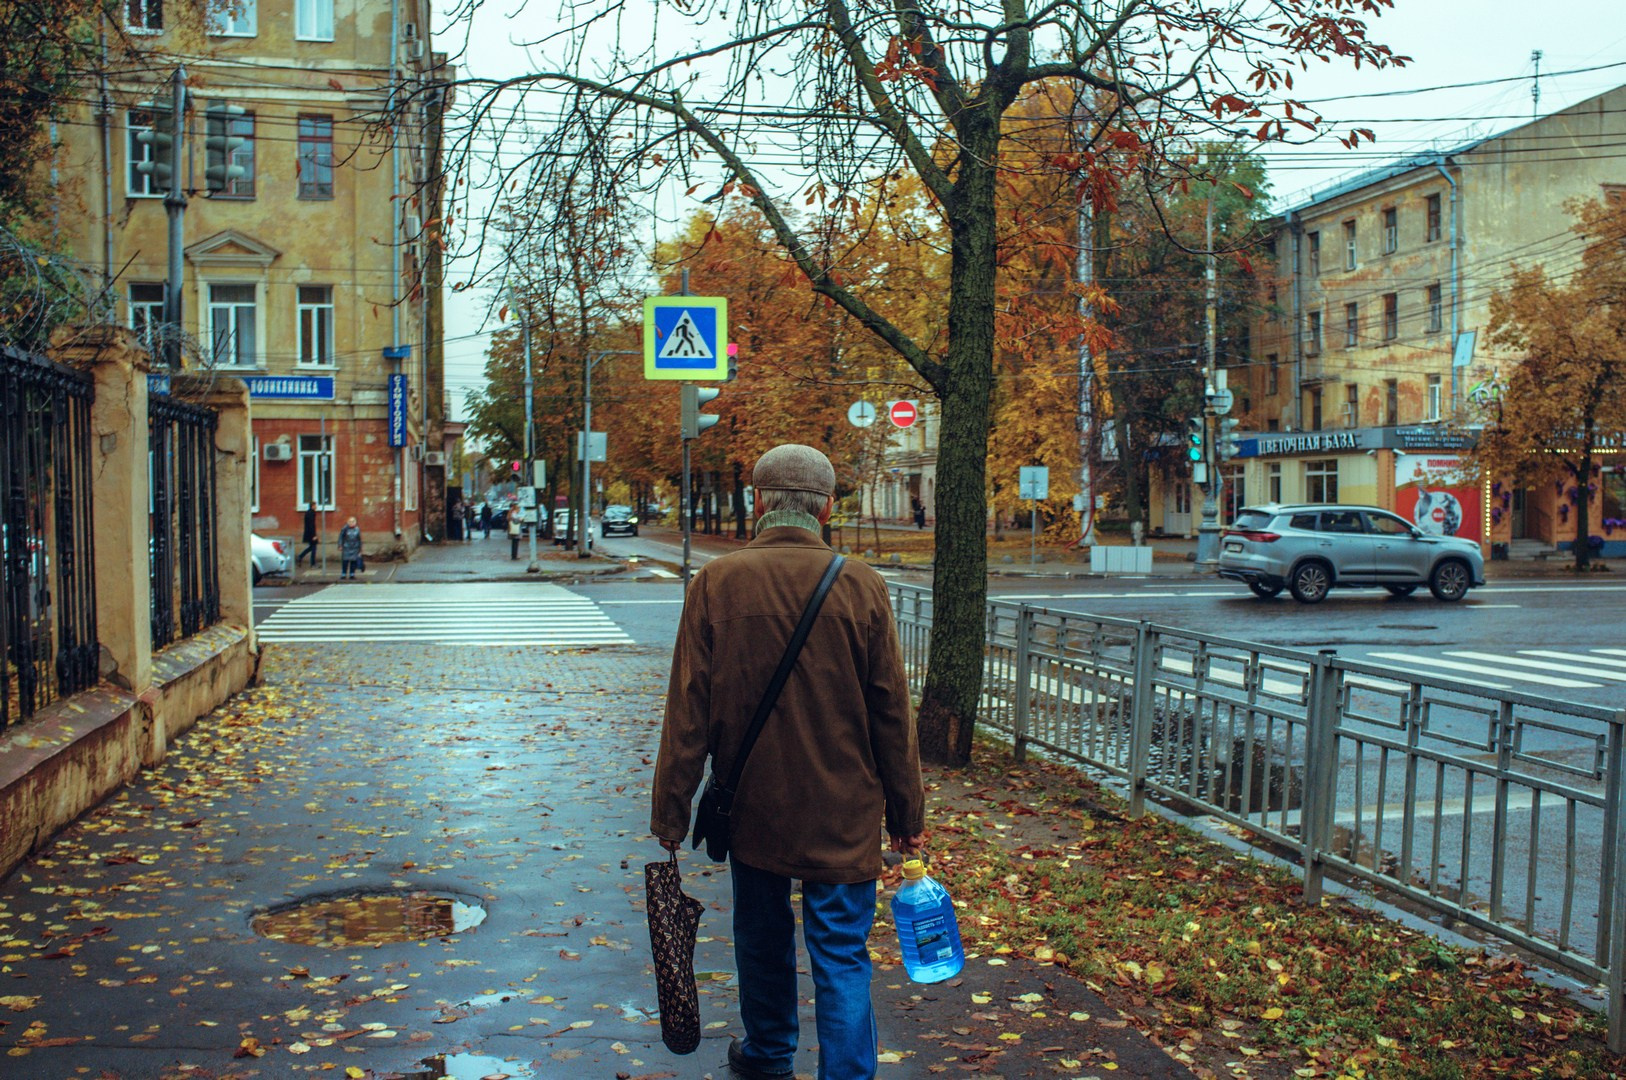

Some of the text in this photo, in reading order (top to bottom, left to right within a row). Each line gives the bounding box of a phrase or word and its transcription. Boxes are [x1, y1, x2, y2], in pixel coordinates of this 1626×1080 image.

[250, 380, 318, 394] ПОЛИКЛИНИКА
[393, 375, 402, 445] СТОМАТОЛОГИЯ
[1258, 432, 1356, 455] ЦВЕТОЧНАЯ БАЗА
